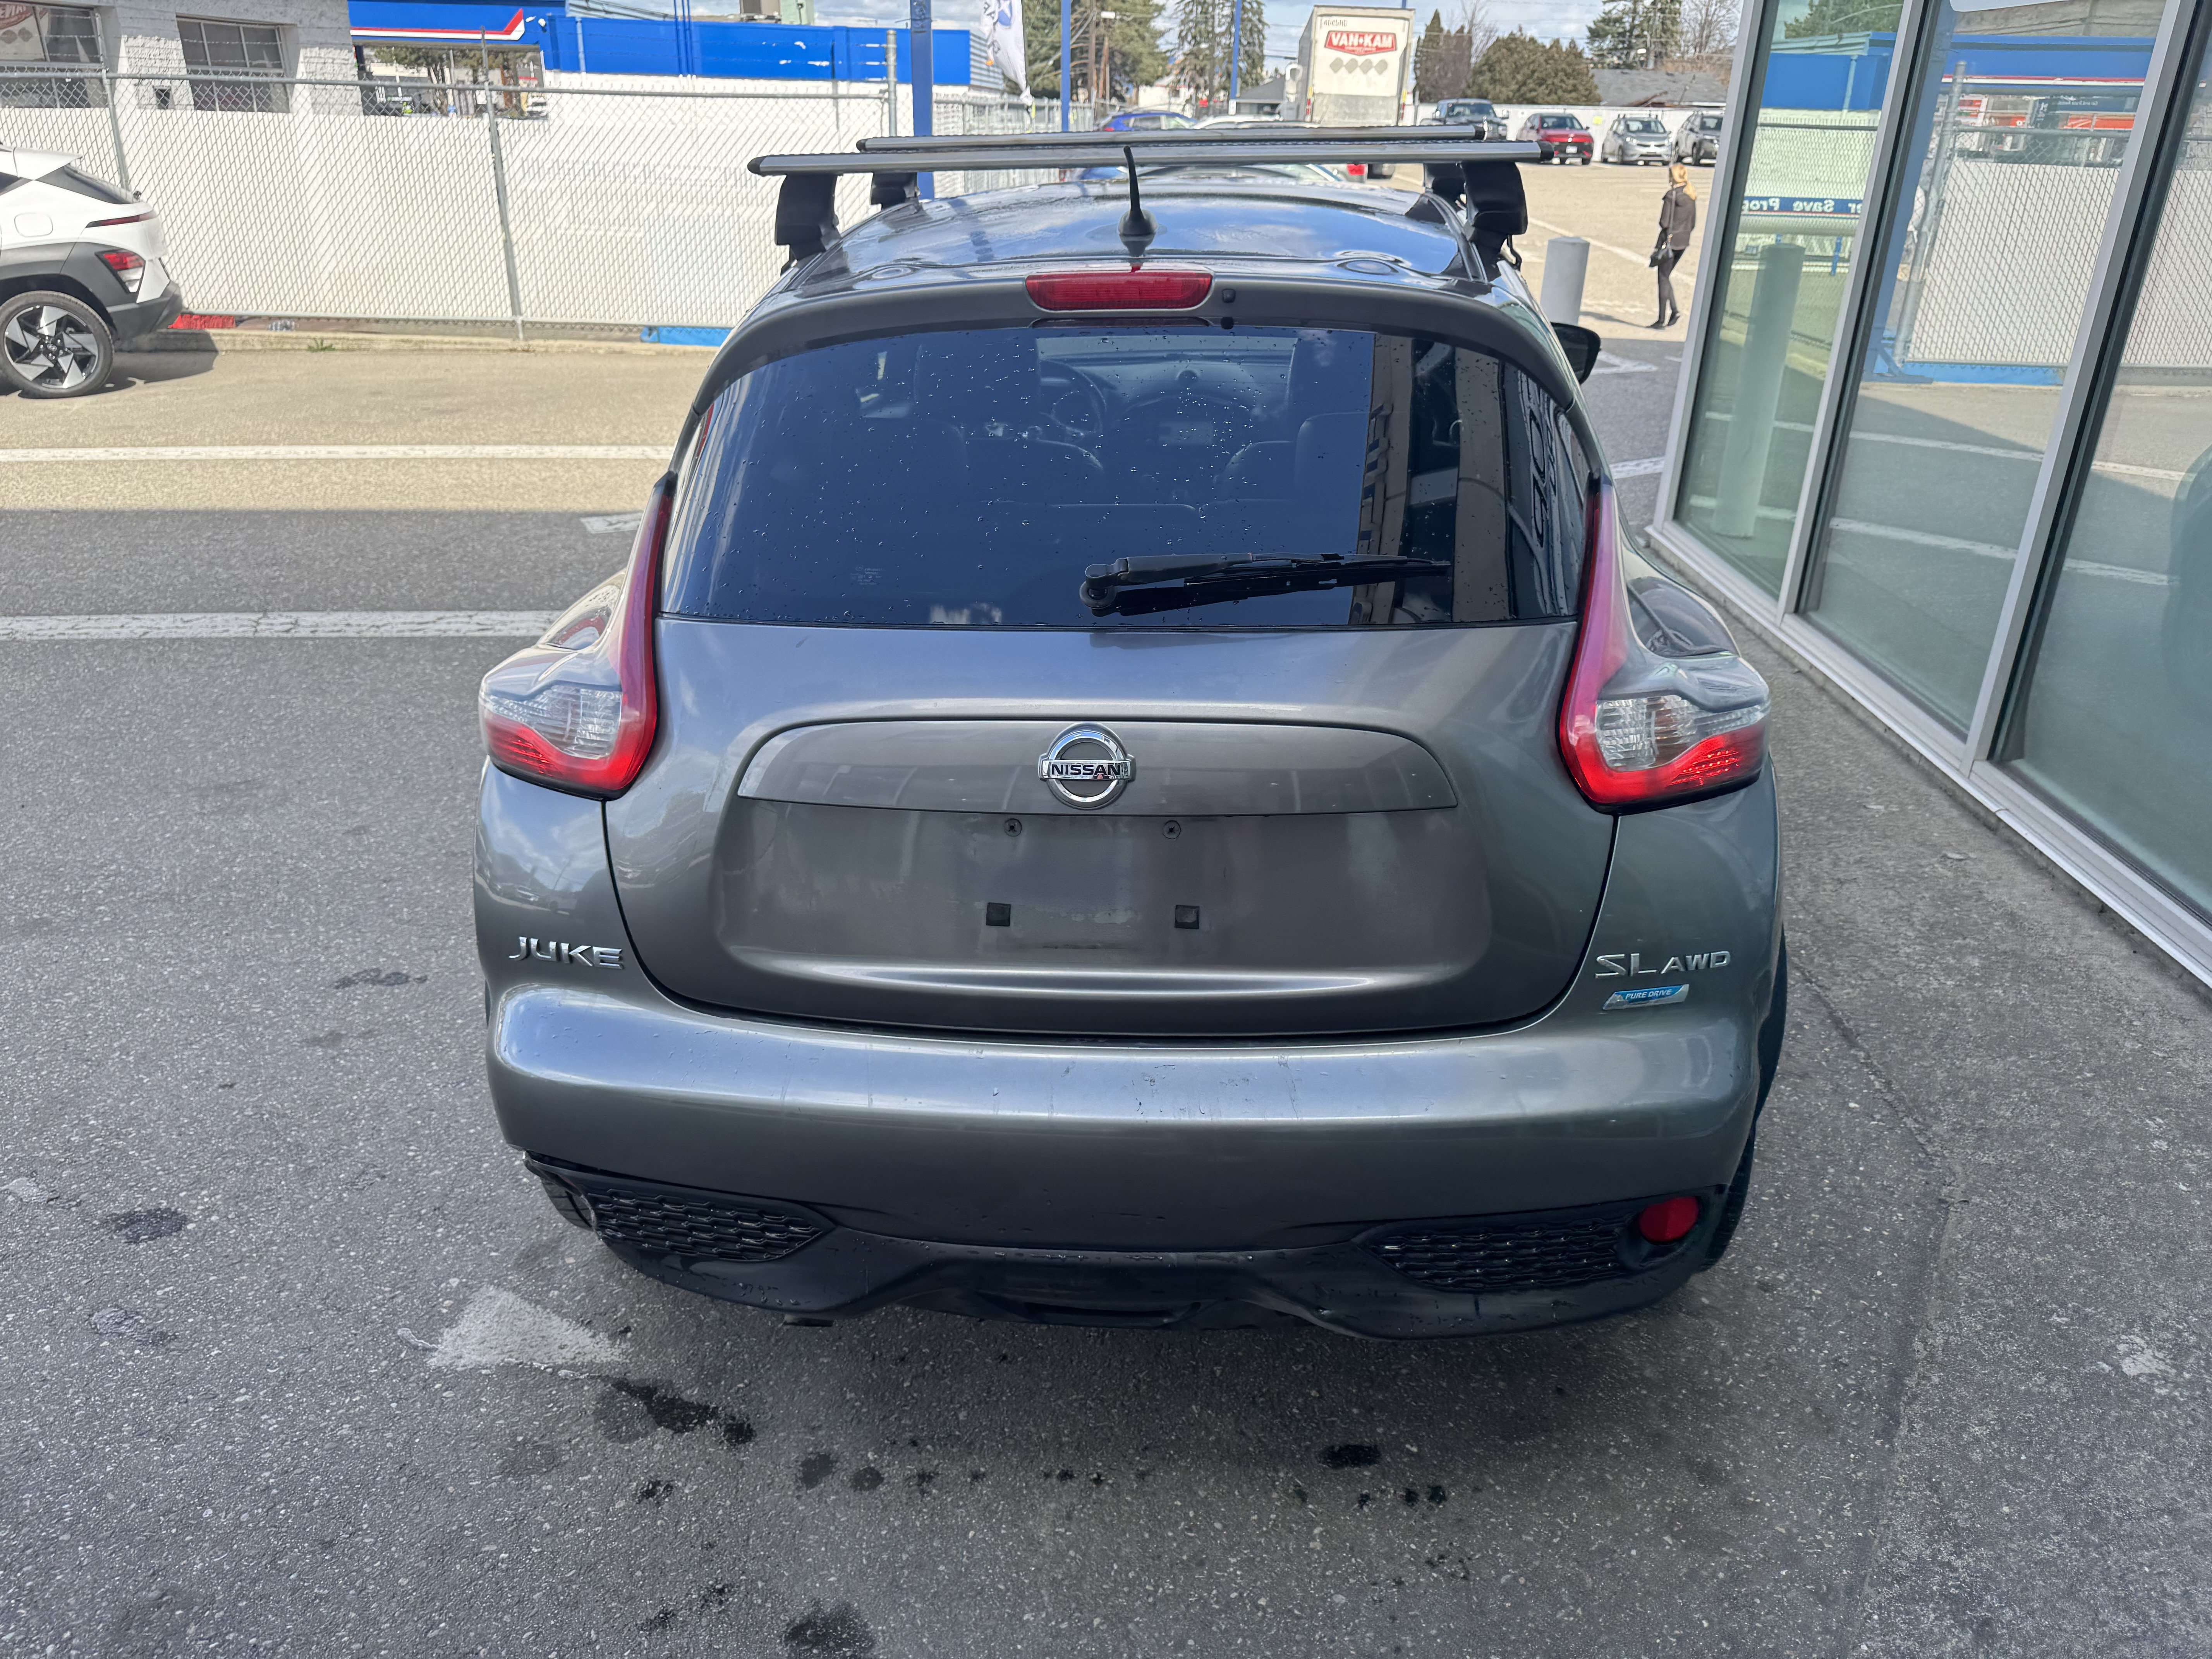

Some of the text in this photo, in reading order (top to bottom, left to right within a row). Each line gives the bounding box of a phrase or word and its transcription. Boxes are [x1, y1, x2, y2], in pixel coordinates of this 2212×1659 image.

[1051, 764, 1120, 775] NISSAN
[509, 936, 623, 970] JUKE
[1595, 951, 1731, 979] SL AWD
[1625, 989, 1673, 1000] PURE DRIVE
